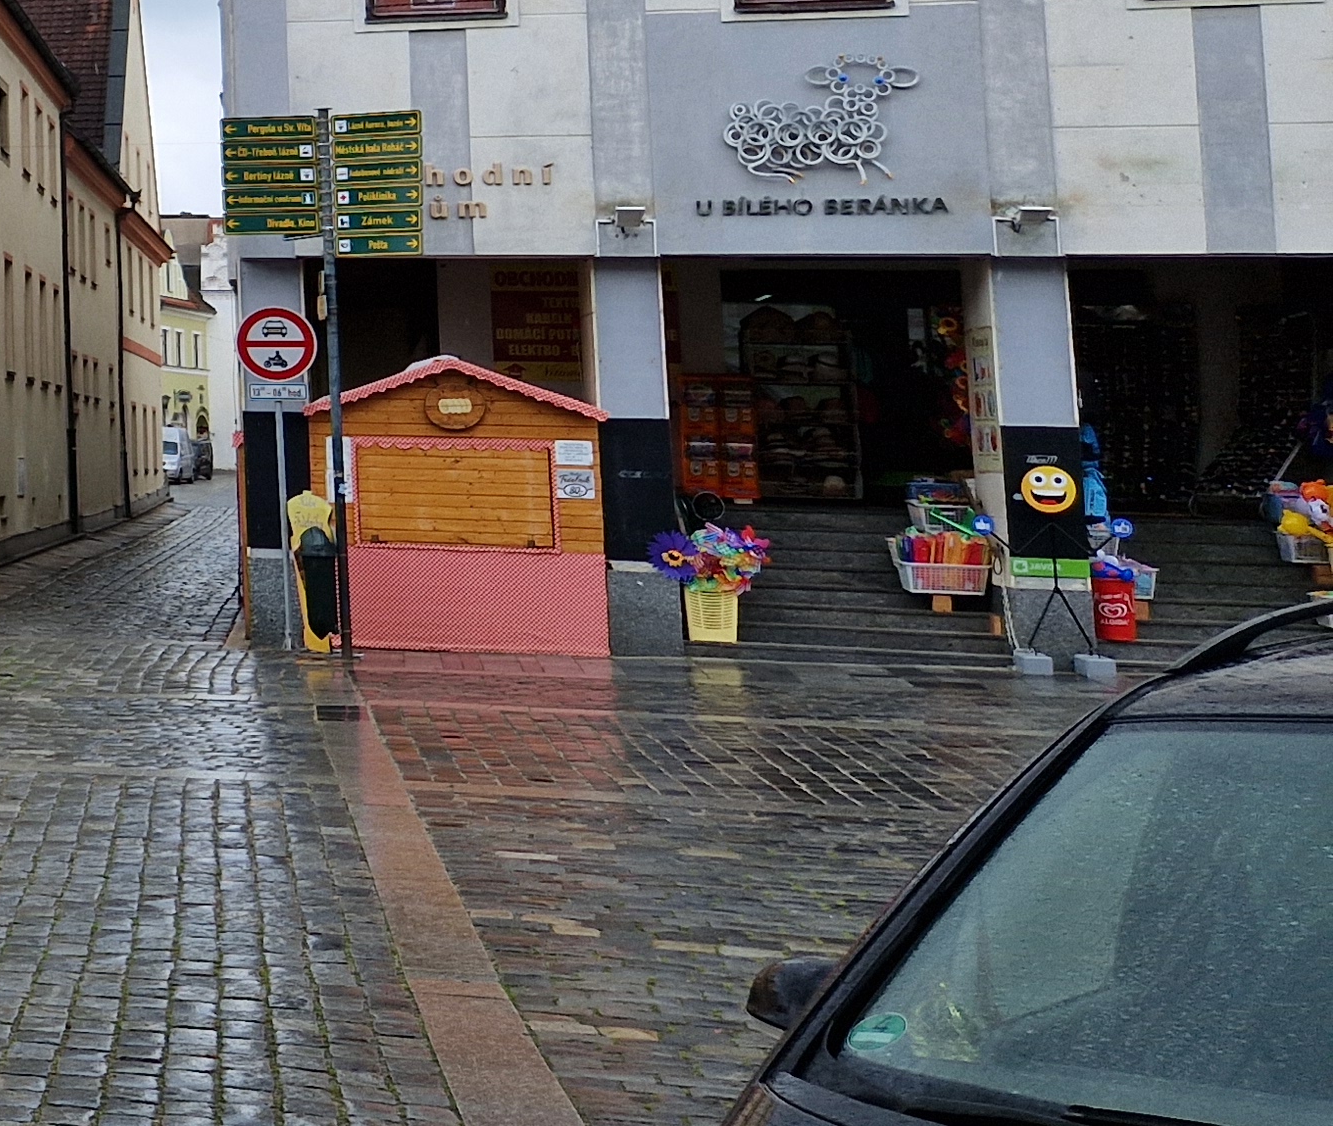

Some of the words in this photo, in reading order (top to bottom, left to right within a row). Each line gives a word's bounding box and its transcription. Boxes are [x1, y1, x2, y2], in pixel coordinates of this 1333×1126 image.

[424, 162, 554, 186] hodní
[358, 190, 397, 201] Poliklinika
[429, 195, 488, 219] ům
[696, 200, 712, 217] U
[722, 196, 813, 217] BÍLÉHO
[823, 194, 949, 217] BERÁNKA
[361, 215, 394, 226] Zámek
[368, 240, 389, 250] Pošta
[493, 270, 579, 287] OBCHODN
[508, 344, 561, 356] ELEKTRO
